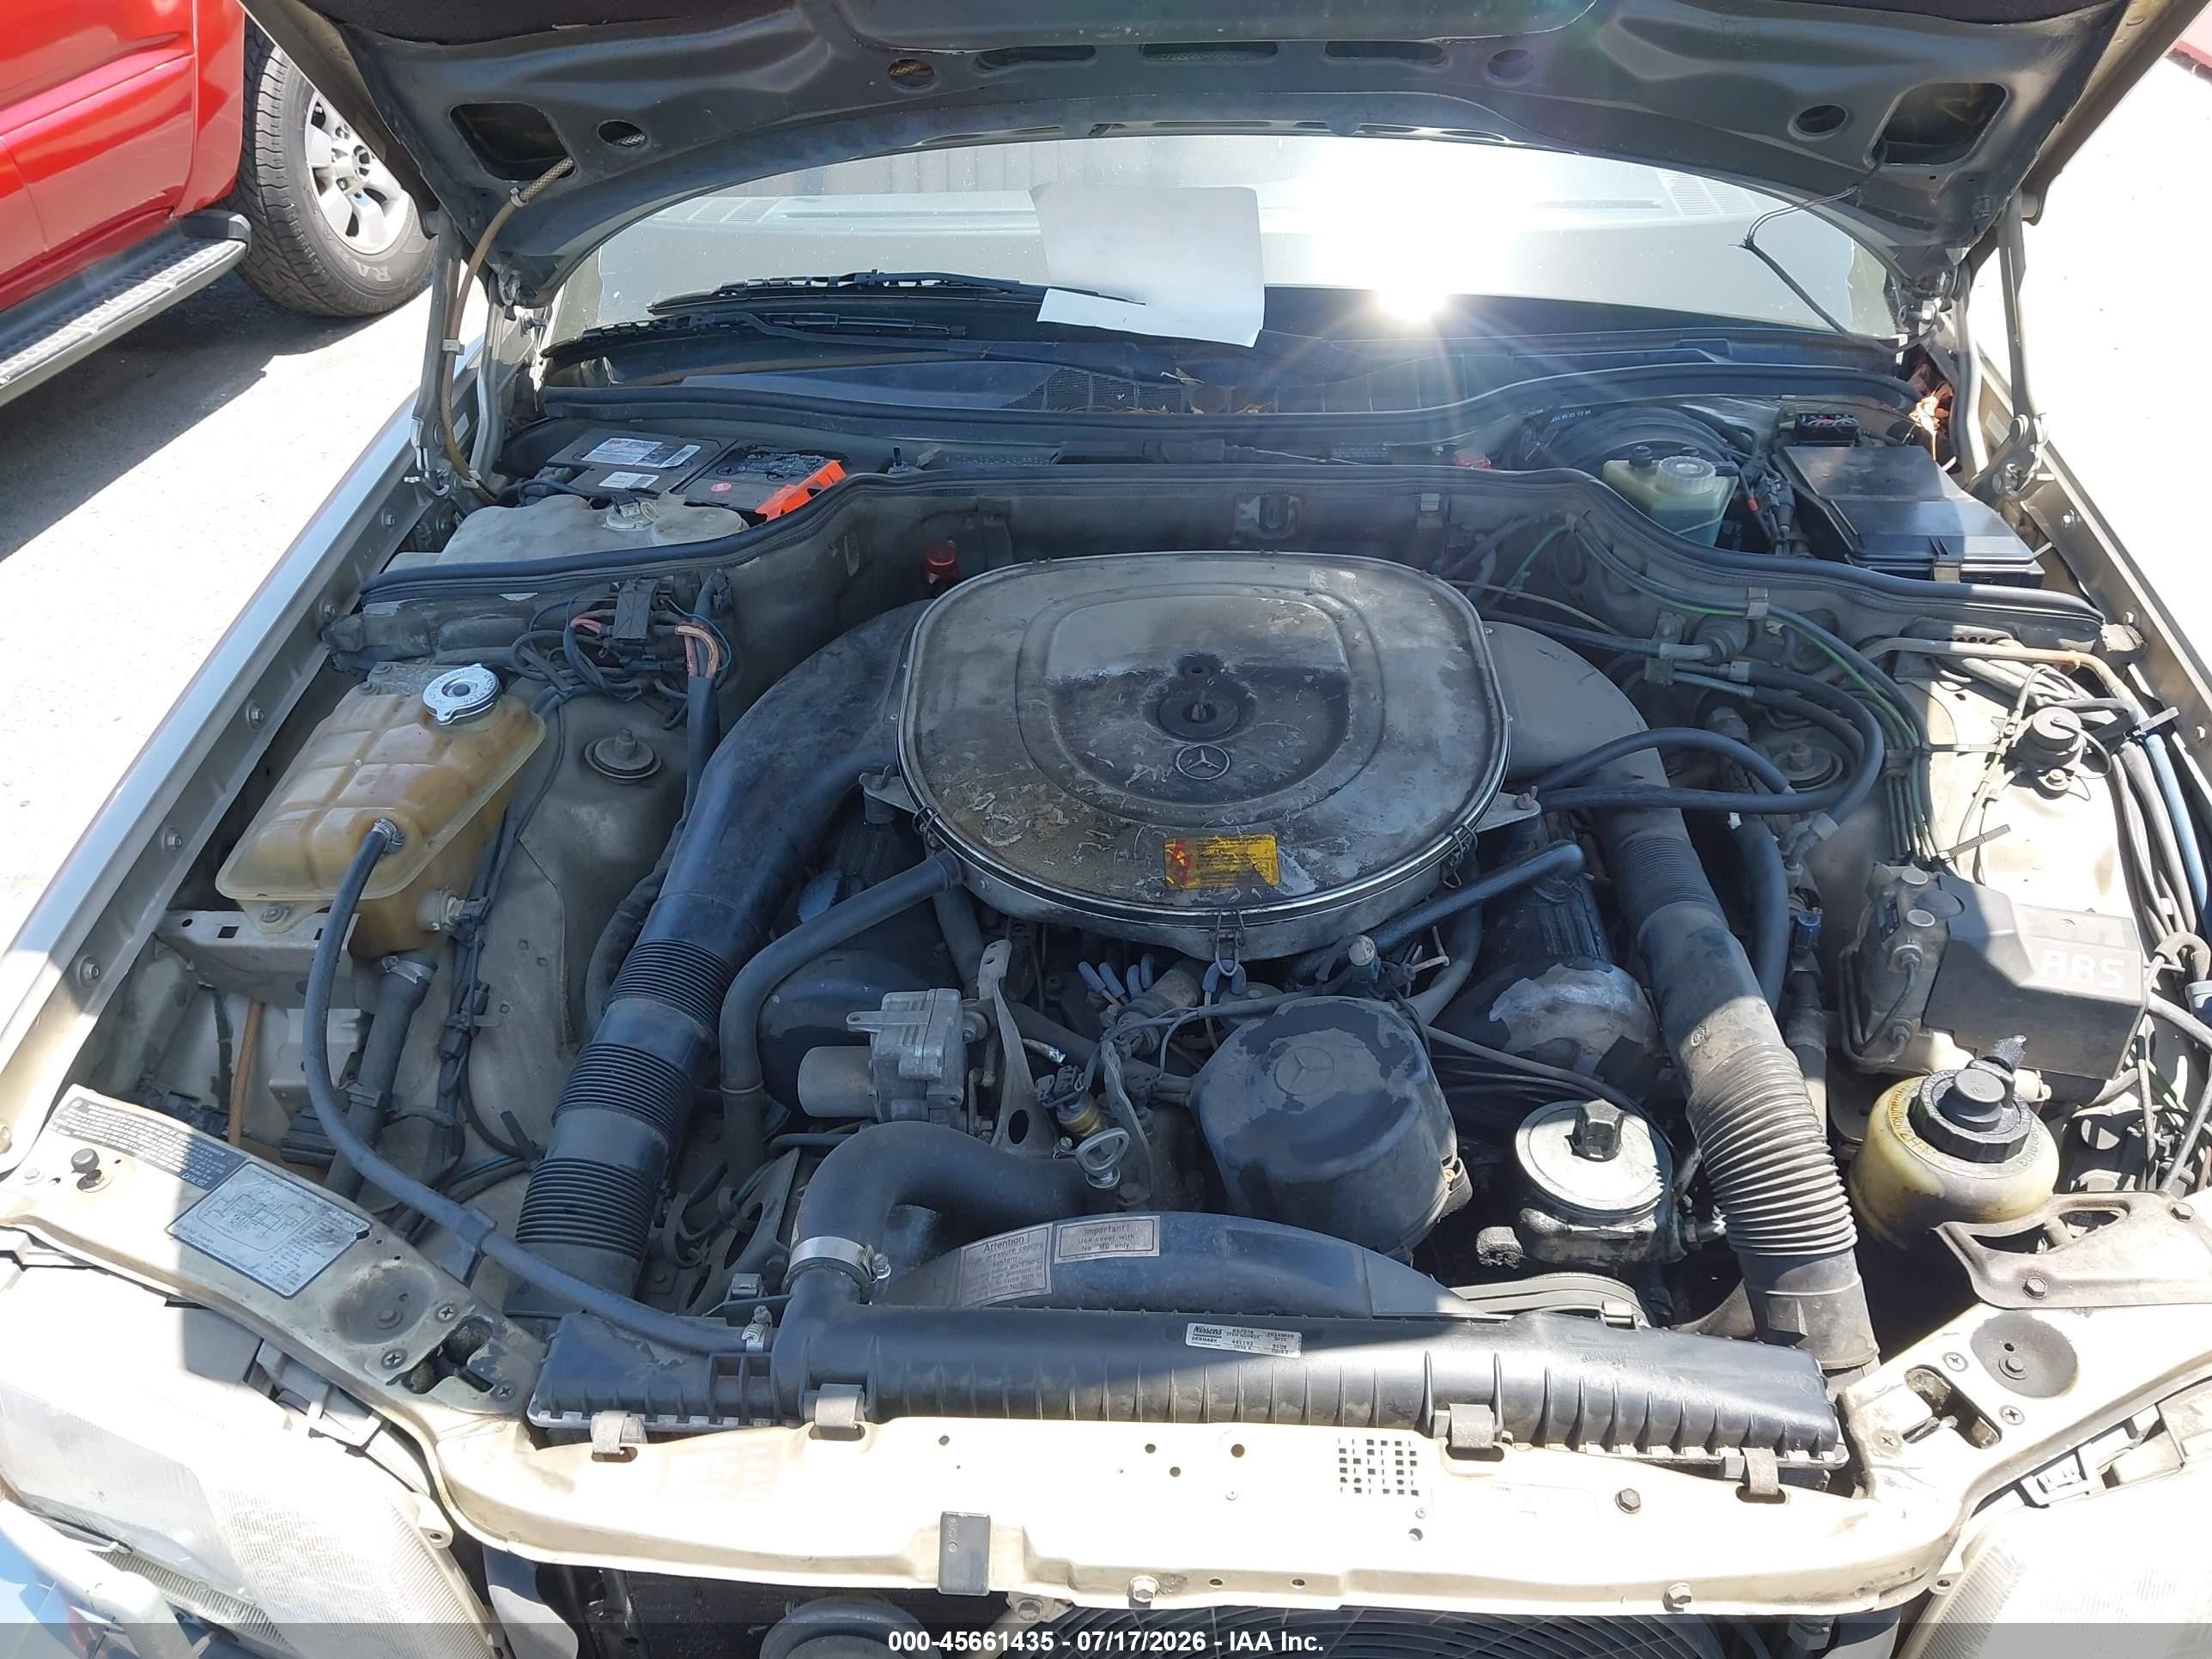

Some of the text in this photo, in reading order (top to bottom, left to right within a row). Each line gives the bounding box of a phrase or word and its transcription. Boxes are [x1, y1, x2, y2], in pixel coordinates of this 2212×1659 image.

[2039, 948, 2125, 990] ABS
[180, 1172, 209, 1187] CATALYST
[1095, 1235, 1115, 1243] cover
[1018, 1241, 1044, 1252] cooling
[1194, 1325, 1224, 1335] Nissens
